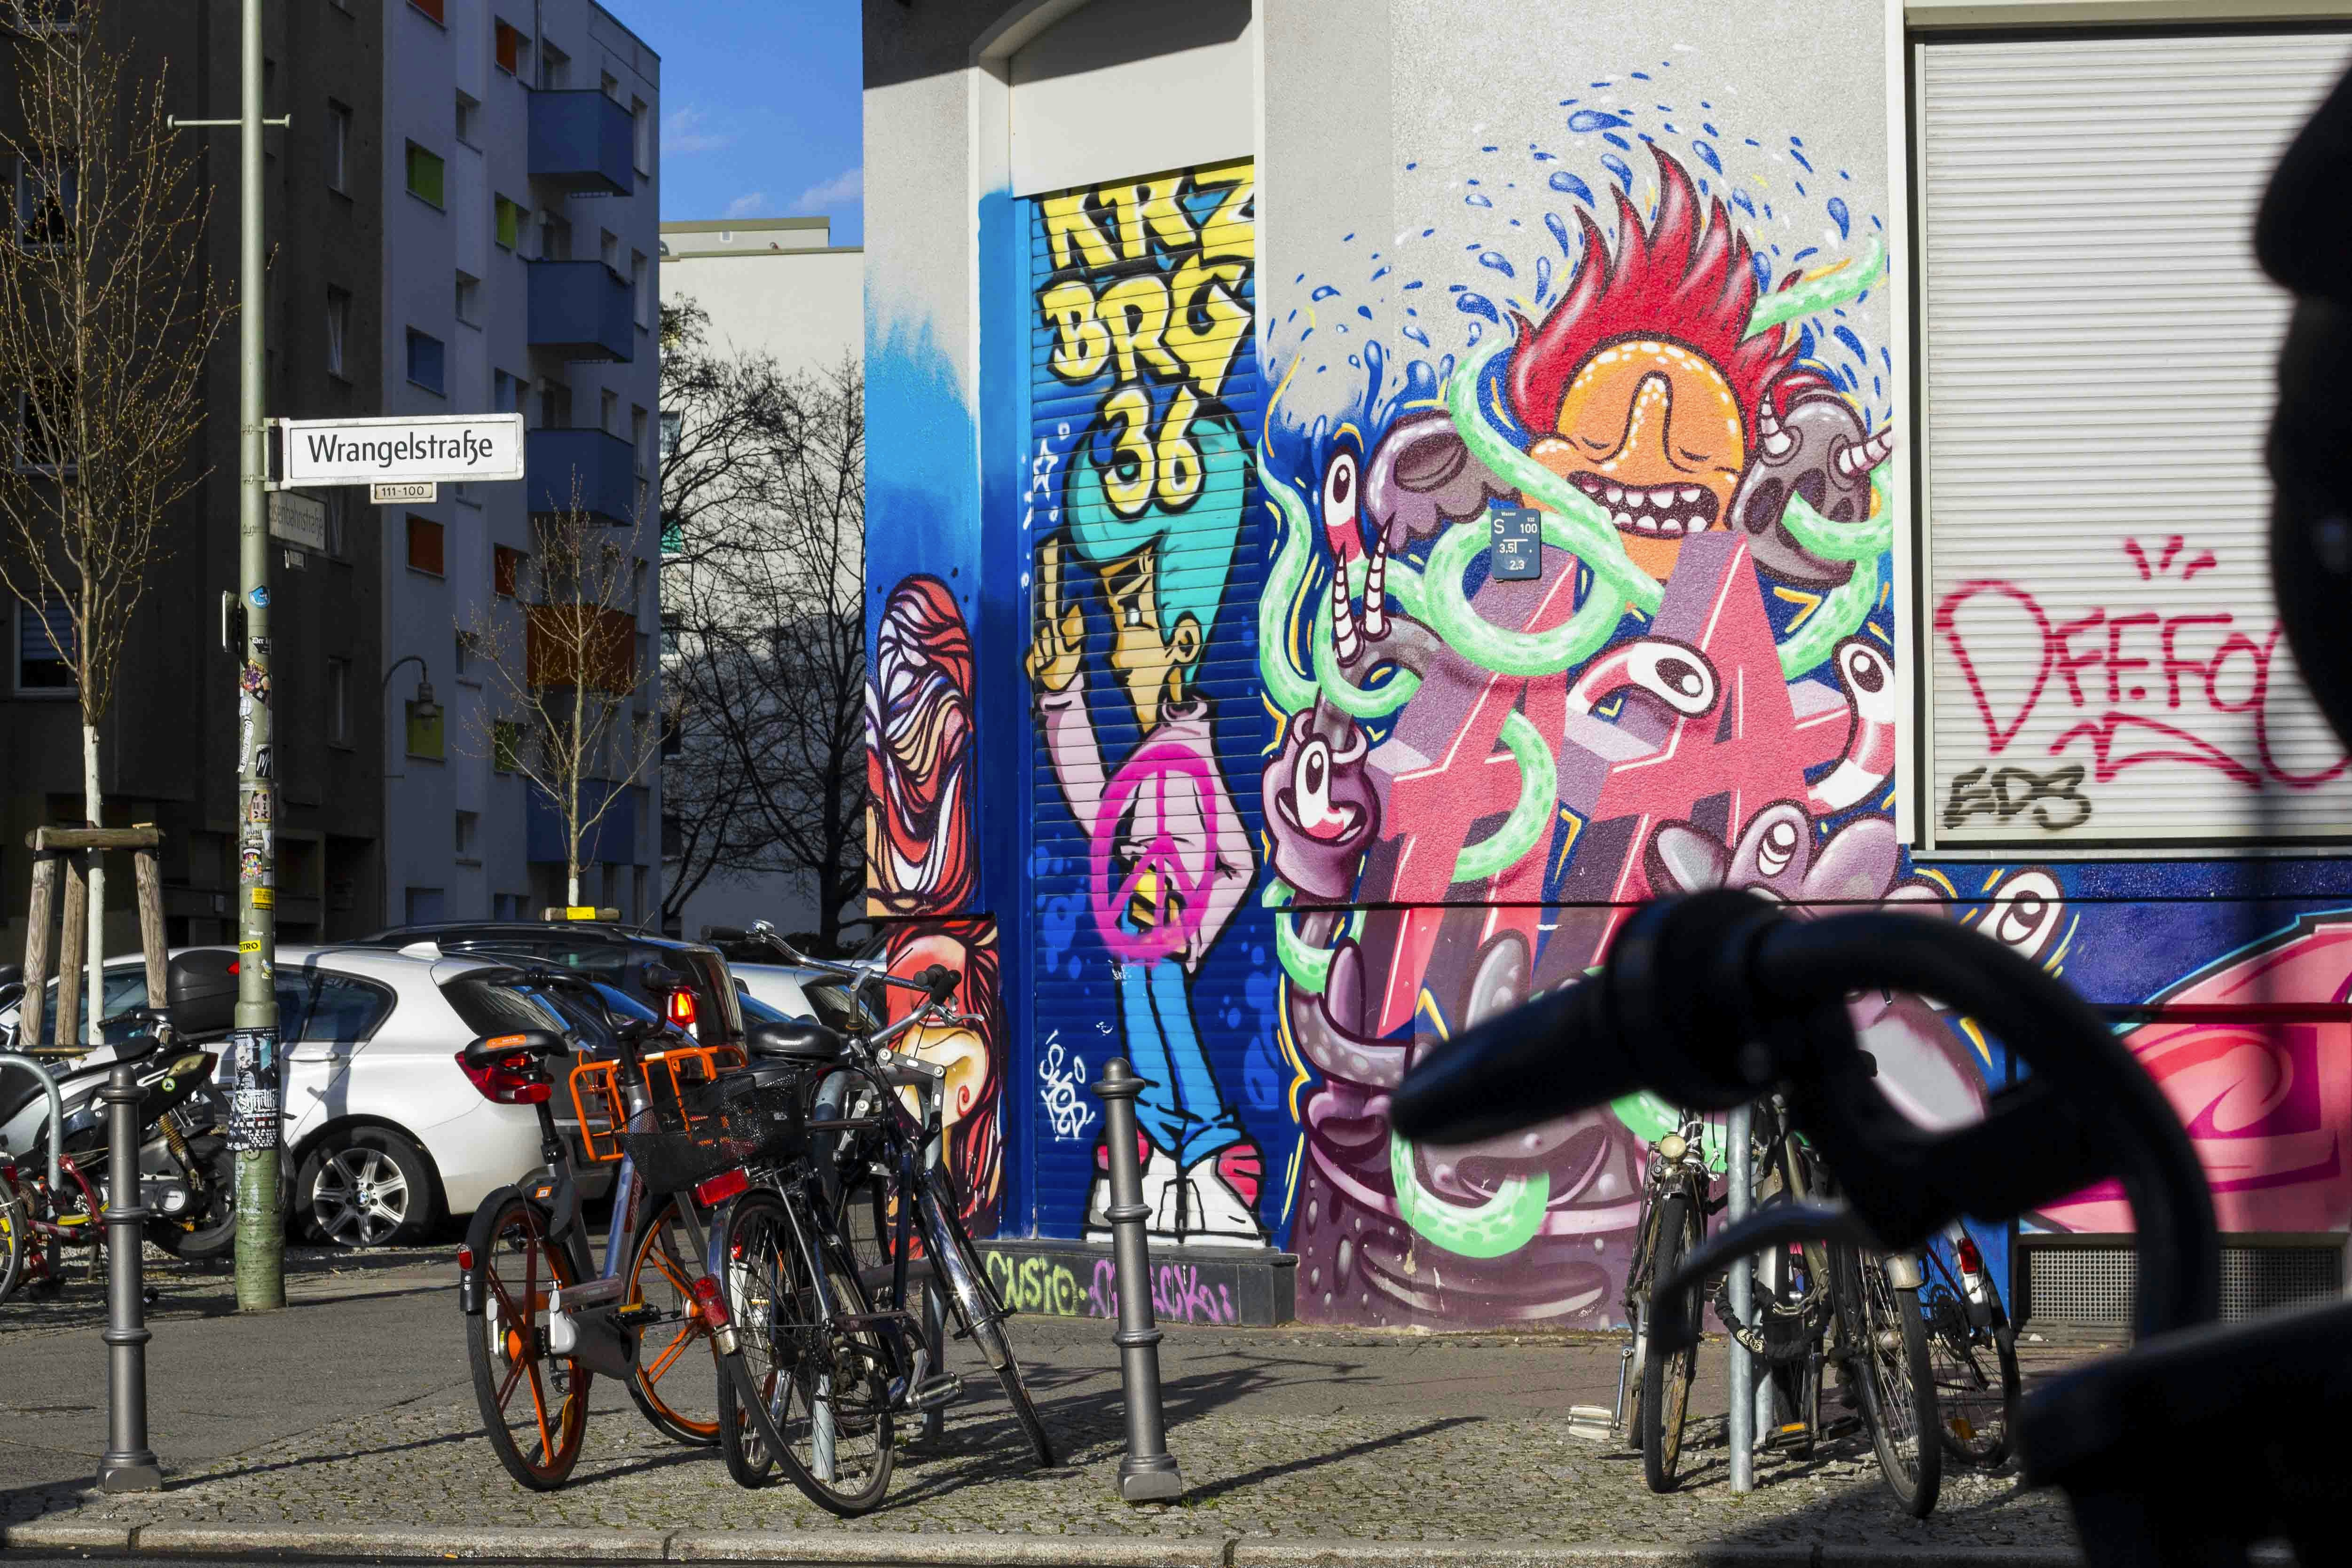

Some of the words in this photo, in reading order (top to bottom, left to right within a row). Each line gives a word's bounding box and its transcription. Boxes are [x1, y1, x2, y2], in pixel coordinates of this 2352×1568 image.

[1040, 254, 1252, 400] BRG
[307, 430, 493, 468] Wrangelstraße
[1103, 385, 1204, 513] 36
[382, 486, 424, 496] 111-100
[1494, 519, 1505, 534] S
[1520, 523, 1537, 534] 100
